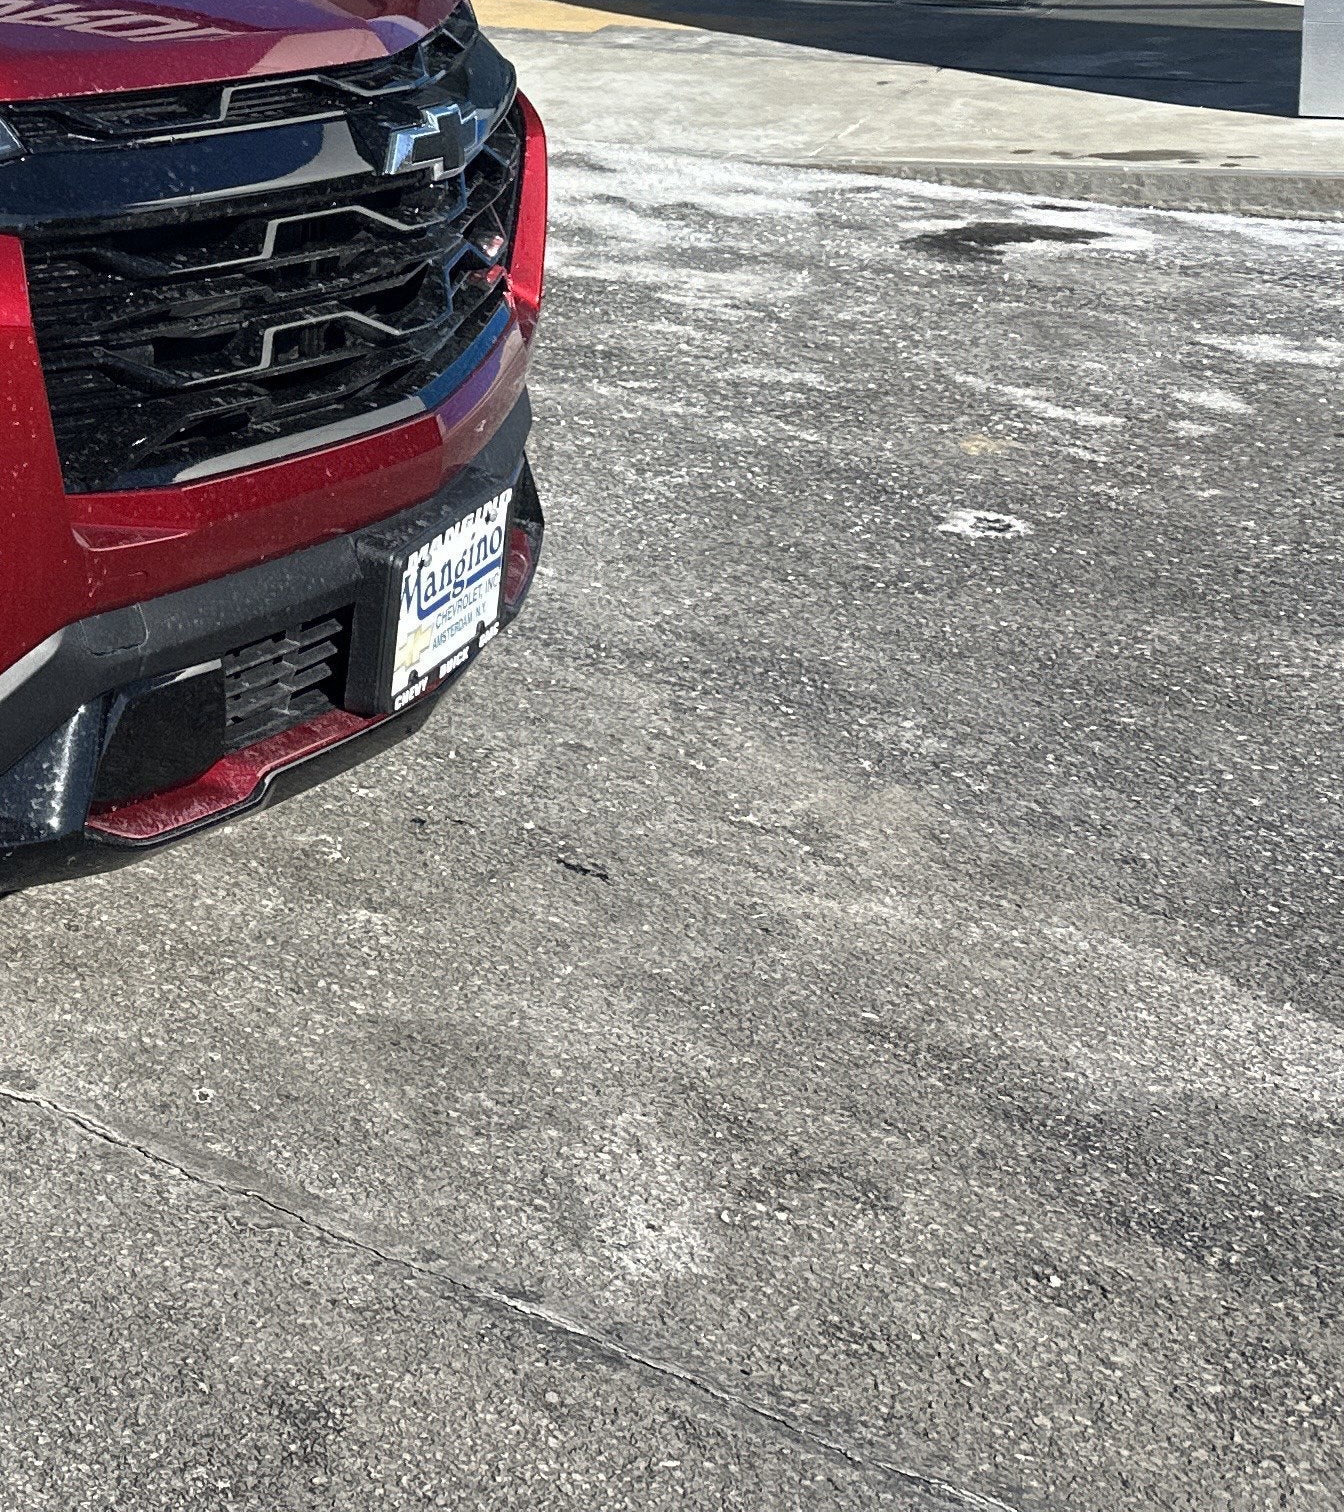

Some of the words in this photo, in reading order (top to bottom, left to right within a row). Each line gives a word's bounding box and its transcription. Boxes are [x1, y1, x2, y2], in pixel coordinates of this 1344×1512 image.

[401, 525, 504, 618] Mangino
[394, 676, 429, 711] CHEVY
[439, 646, 470, 679] BUICK
